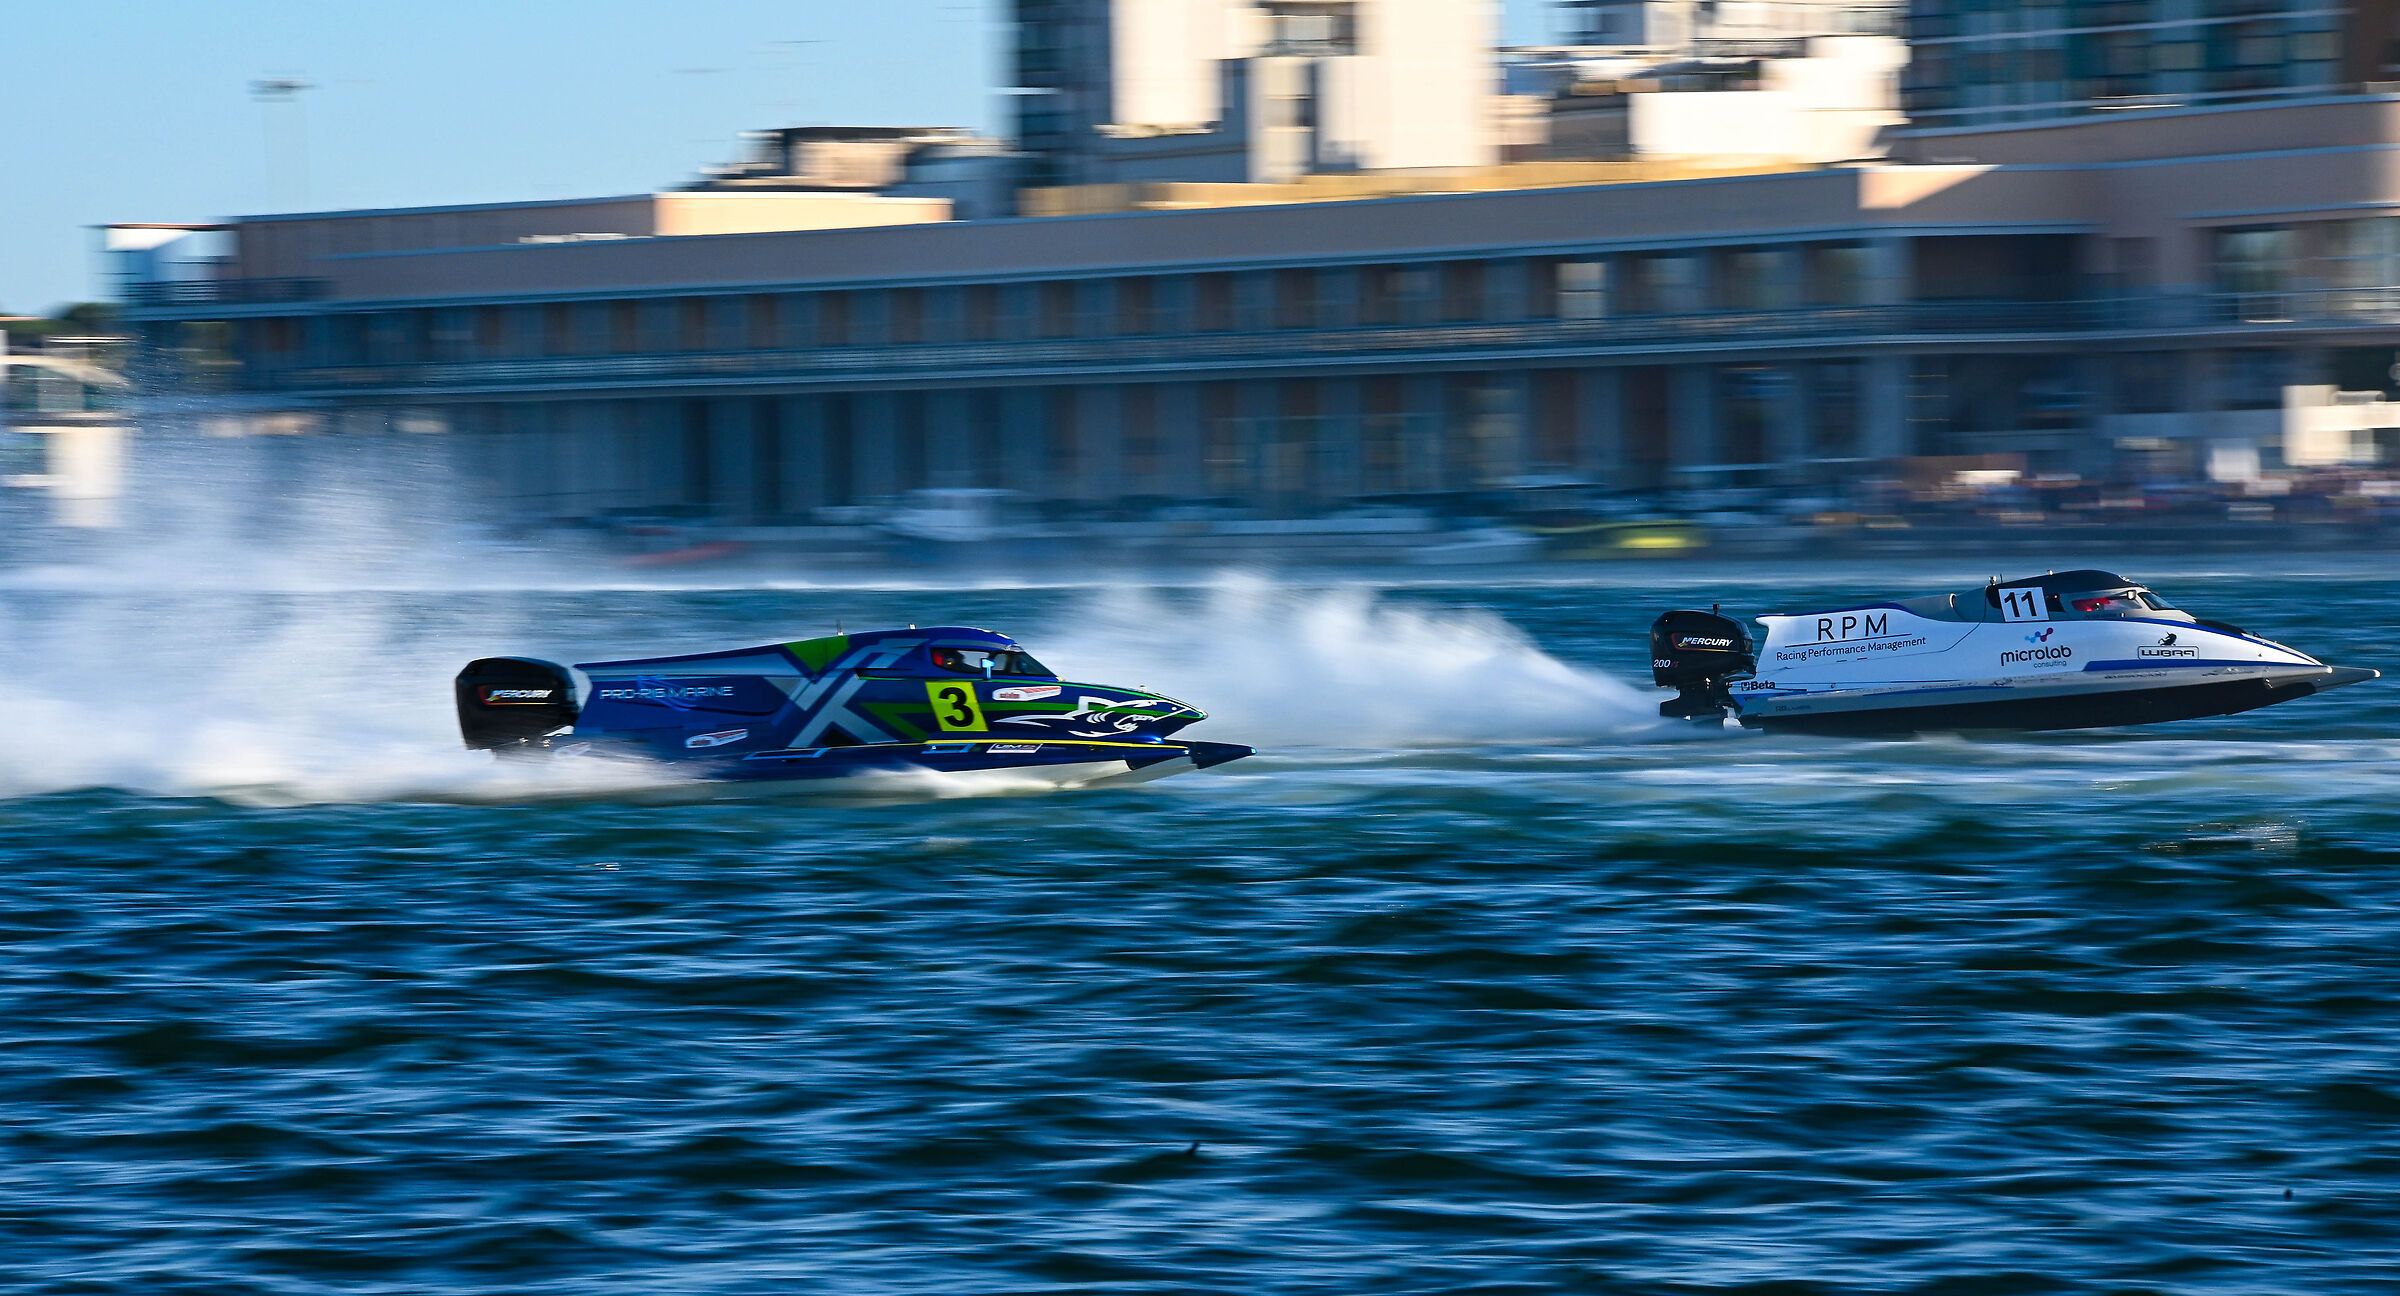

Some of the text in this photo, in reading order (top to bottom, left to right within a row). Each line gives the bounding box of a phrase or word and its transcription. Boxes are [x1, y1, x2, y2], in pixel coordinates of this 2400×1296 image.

[2004, 591, 2037, 617] 11
[1817, 613, 1887, 641] RPM
[1681, 636, 1733, 647] MERCURY
[1776, 636, 1926, 661] Racing Performance Management
[2001, 645, 2072, 667] microlab
[1653, 659, 1671, 669] 200
[2033, 660, 2067, 669] consulting
[1751, 680, 1776, 690] Beta
[488, 689, 553, 700] MERCURY
[668, 686, 734, 697] MARINE
[938, 687, 974, 728] 3
